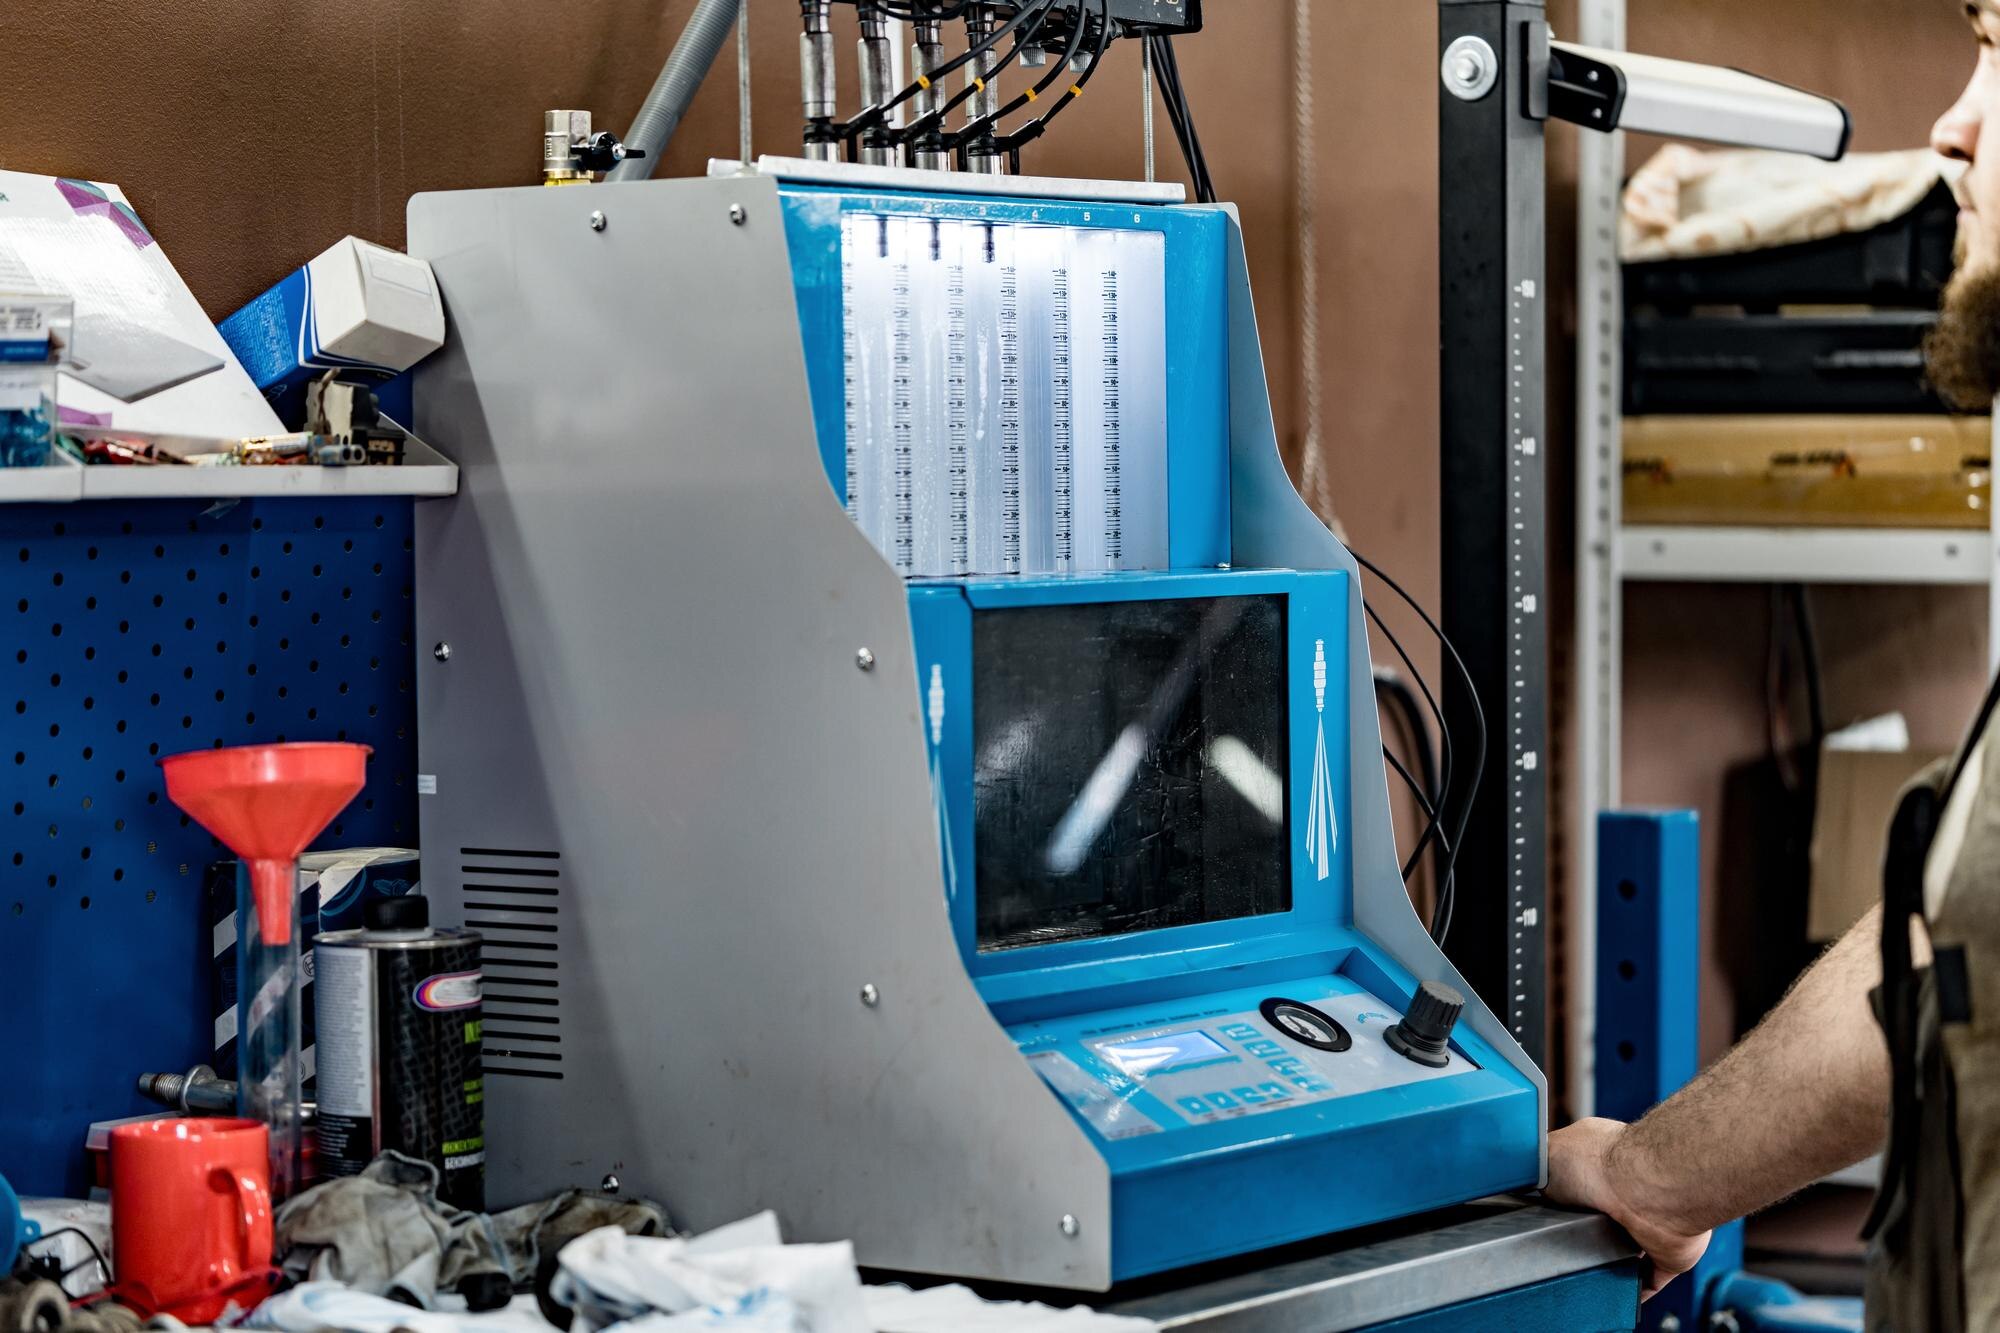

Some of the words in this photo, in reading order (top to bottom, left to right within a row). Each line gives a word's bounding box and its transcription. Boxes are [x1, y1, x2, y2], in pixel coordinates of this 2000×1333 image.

[1032, 210, 1038, 219] 4
[1084, 212, 1090, 221] 5
[1134, 214, 1140, 223] 6
[1522, 594, 1536, 613] 130
[1523, 751, 1537, 770] 120
[1523, 907, 1537, 926] 110
